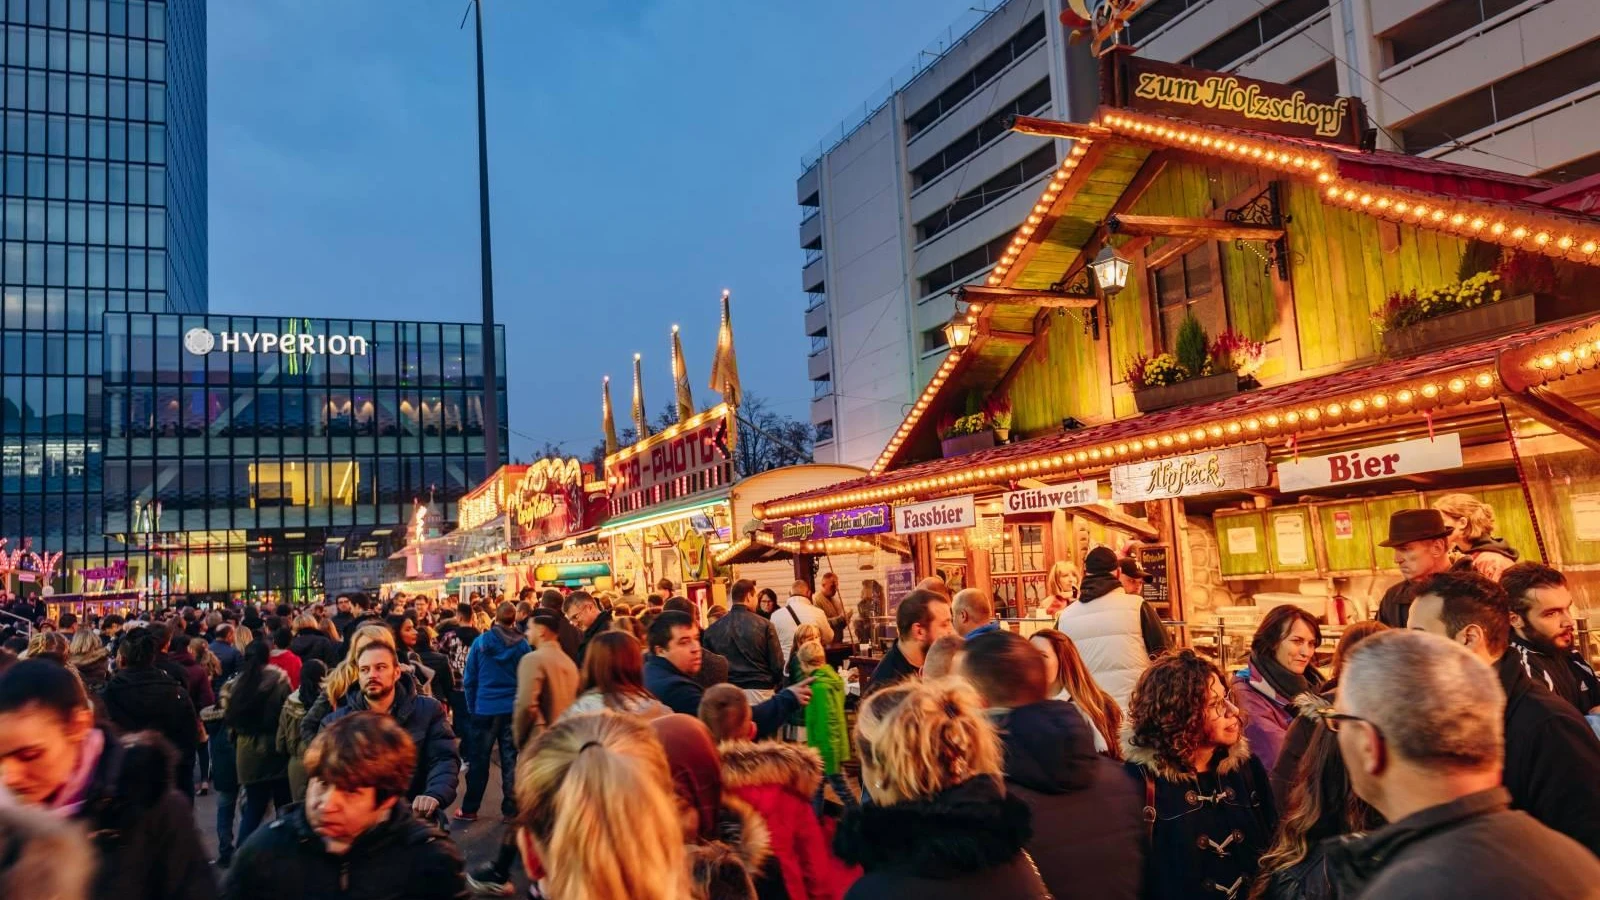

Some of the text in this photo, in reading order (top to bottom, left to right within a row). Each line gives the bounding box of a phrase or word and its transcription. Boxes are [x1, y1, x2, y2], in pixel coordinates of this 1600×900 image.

[1136, 74, 1348, 136] zum Holzschopf
[1146, 453, 1226, 495] Alpfleck
[1328, 452, 1400, 483] Bier
[1009, 484, 1090, 511] Glühwein
[903, 504, 963, 529] Fassbier
